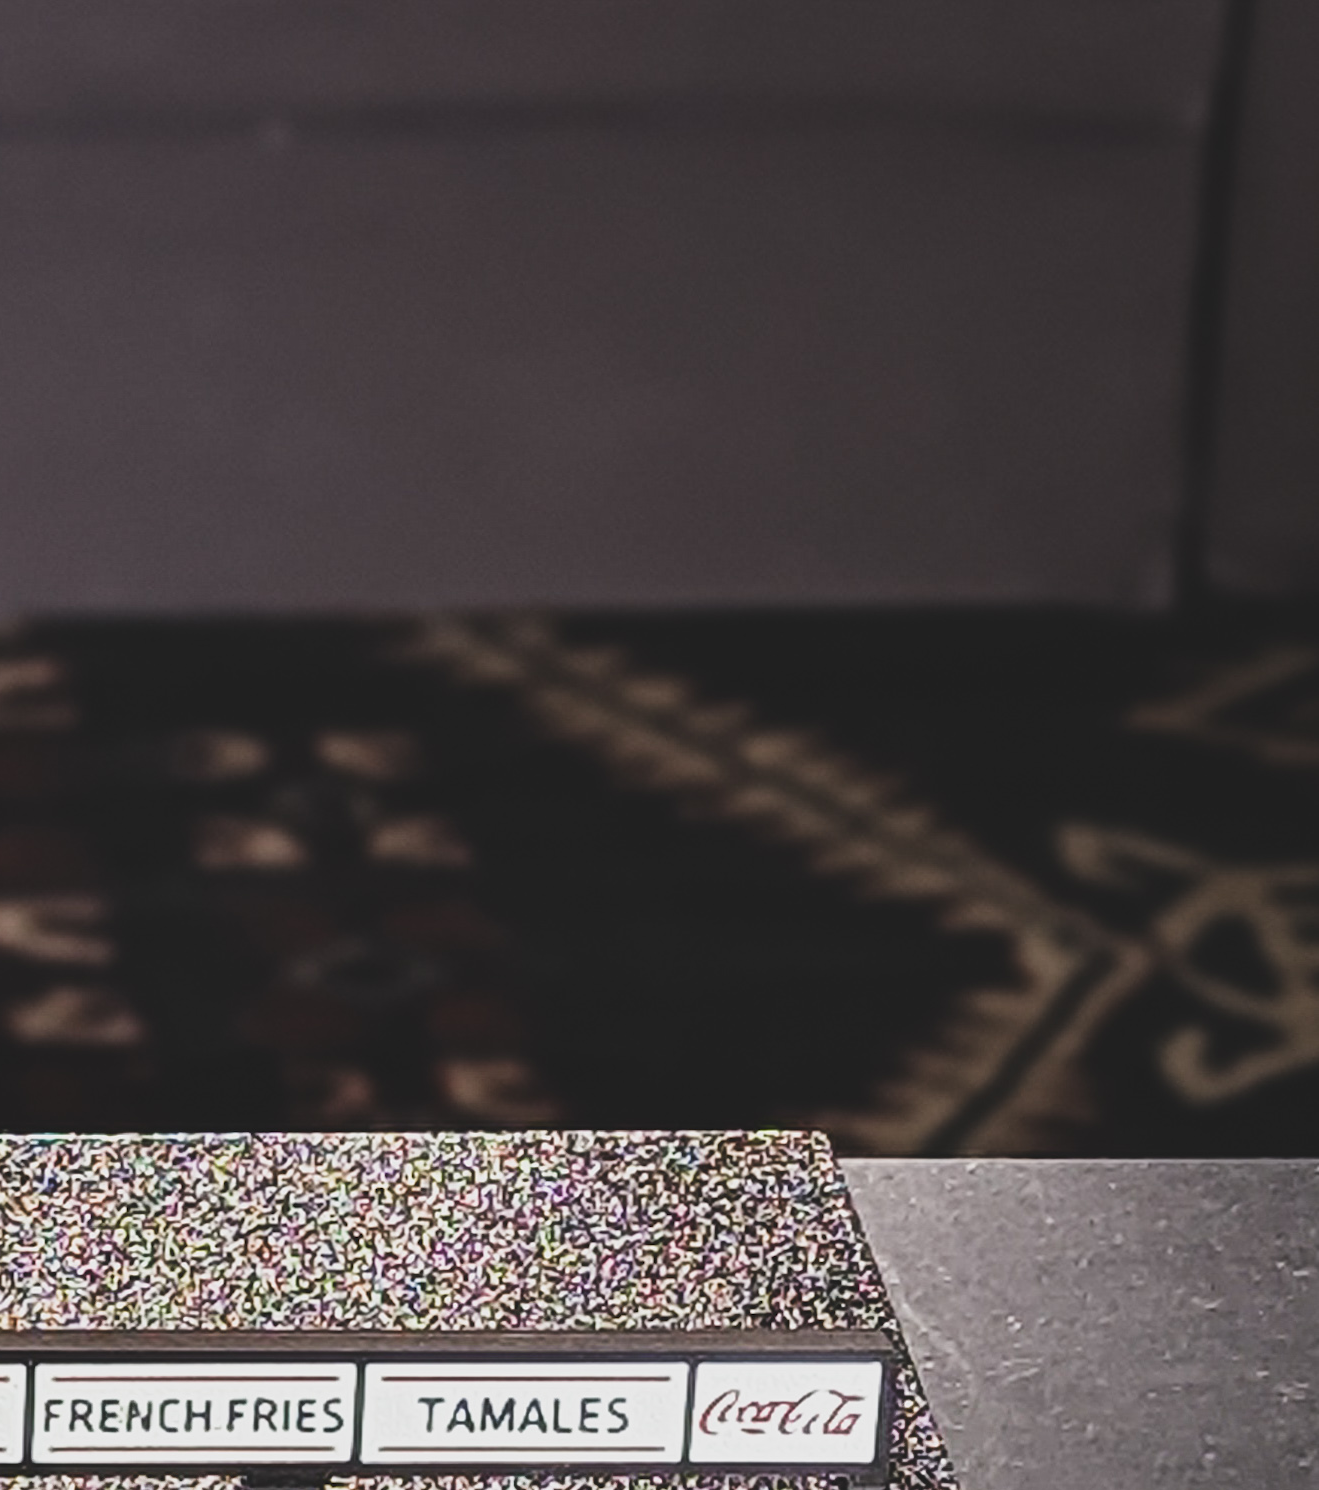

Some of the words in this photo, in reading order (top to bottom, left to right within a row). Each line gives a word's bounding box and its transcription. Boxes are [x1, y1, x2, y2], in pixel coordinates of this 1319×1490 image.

[45, 1400, 211, 1432] FRENCH
[227, 1398, 343, 1432] FRIES
[419, 1398, 628, 1433] TAMALES
